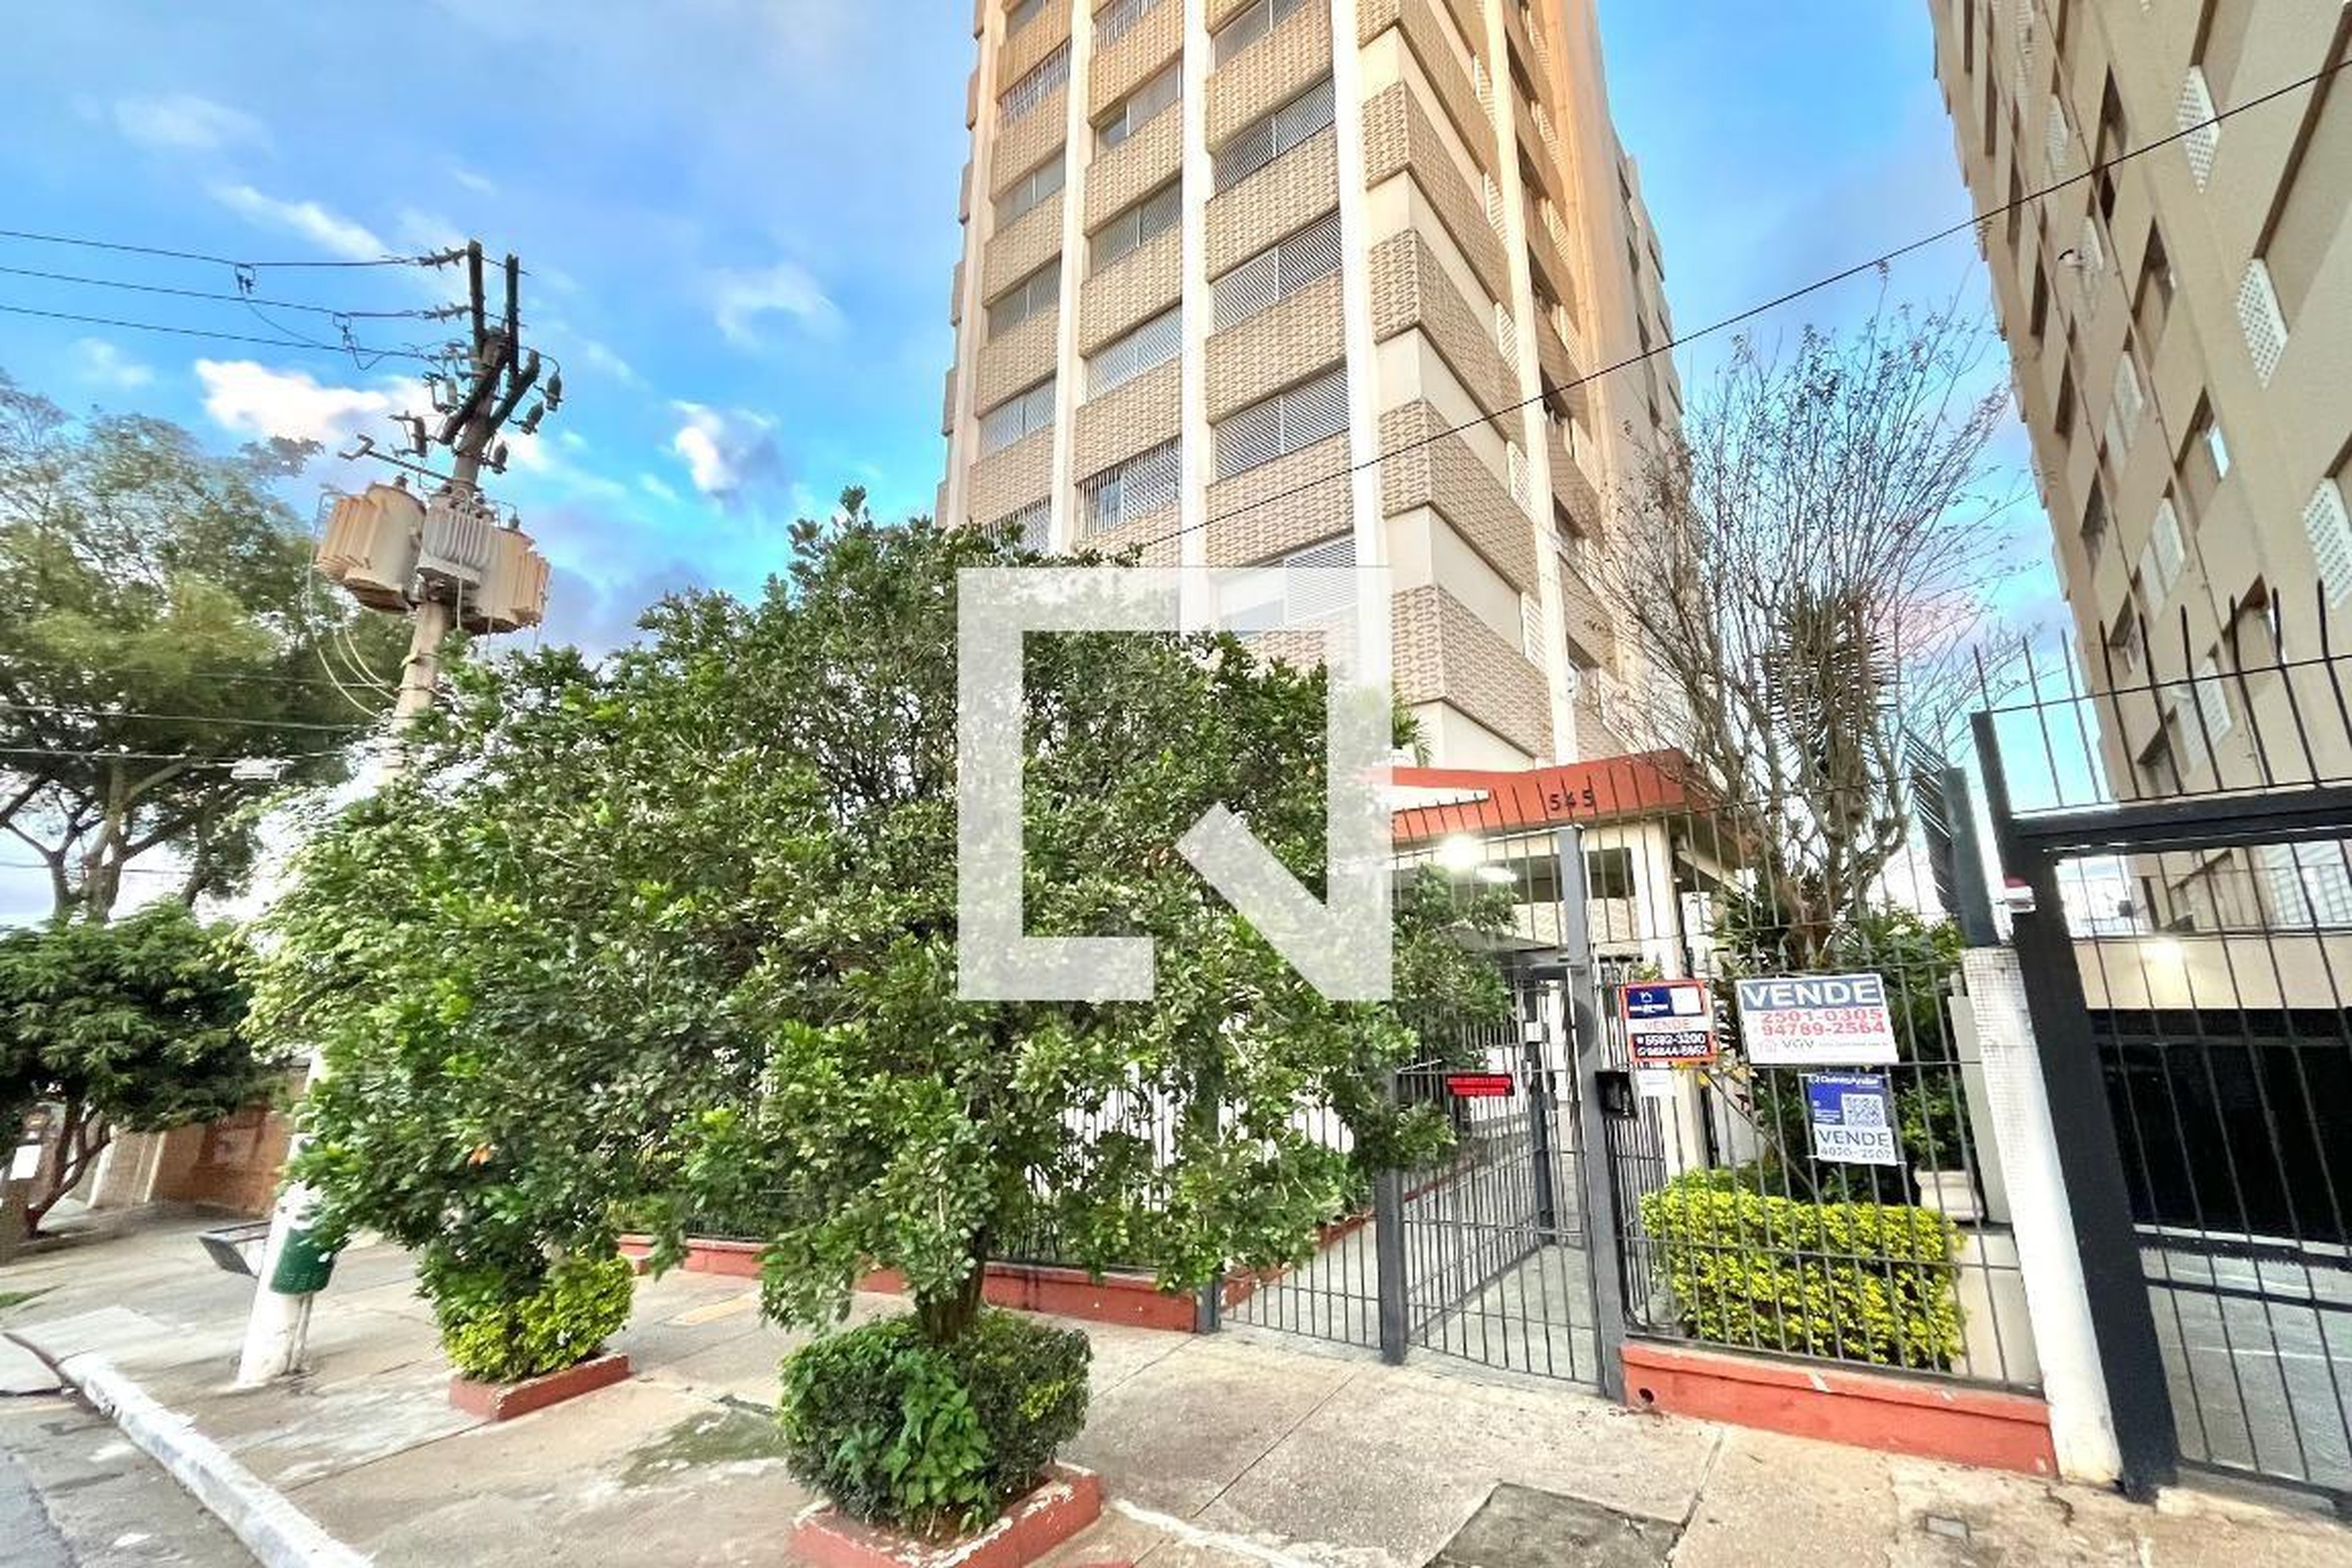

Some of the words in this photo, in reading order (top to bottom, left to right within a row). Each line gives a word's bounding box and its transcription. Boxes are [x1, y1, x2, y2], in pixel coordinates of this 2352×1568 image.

[1549, 789, 1594, 811] 545
[1742, 980, 1880, 1007] VENDE
[1760, 1009, 1883, 1023] 2501-0305
[1645, 1019, 1691, 1030] VENDE
[1762, 1022, 1885, 1036] 94789-2564
[1817, 1129, 1889, 1147] VENDE
